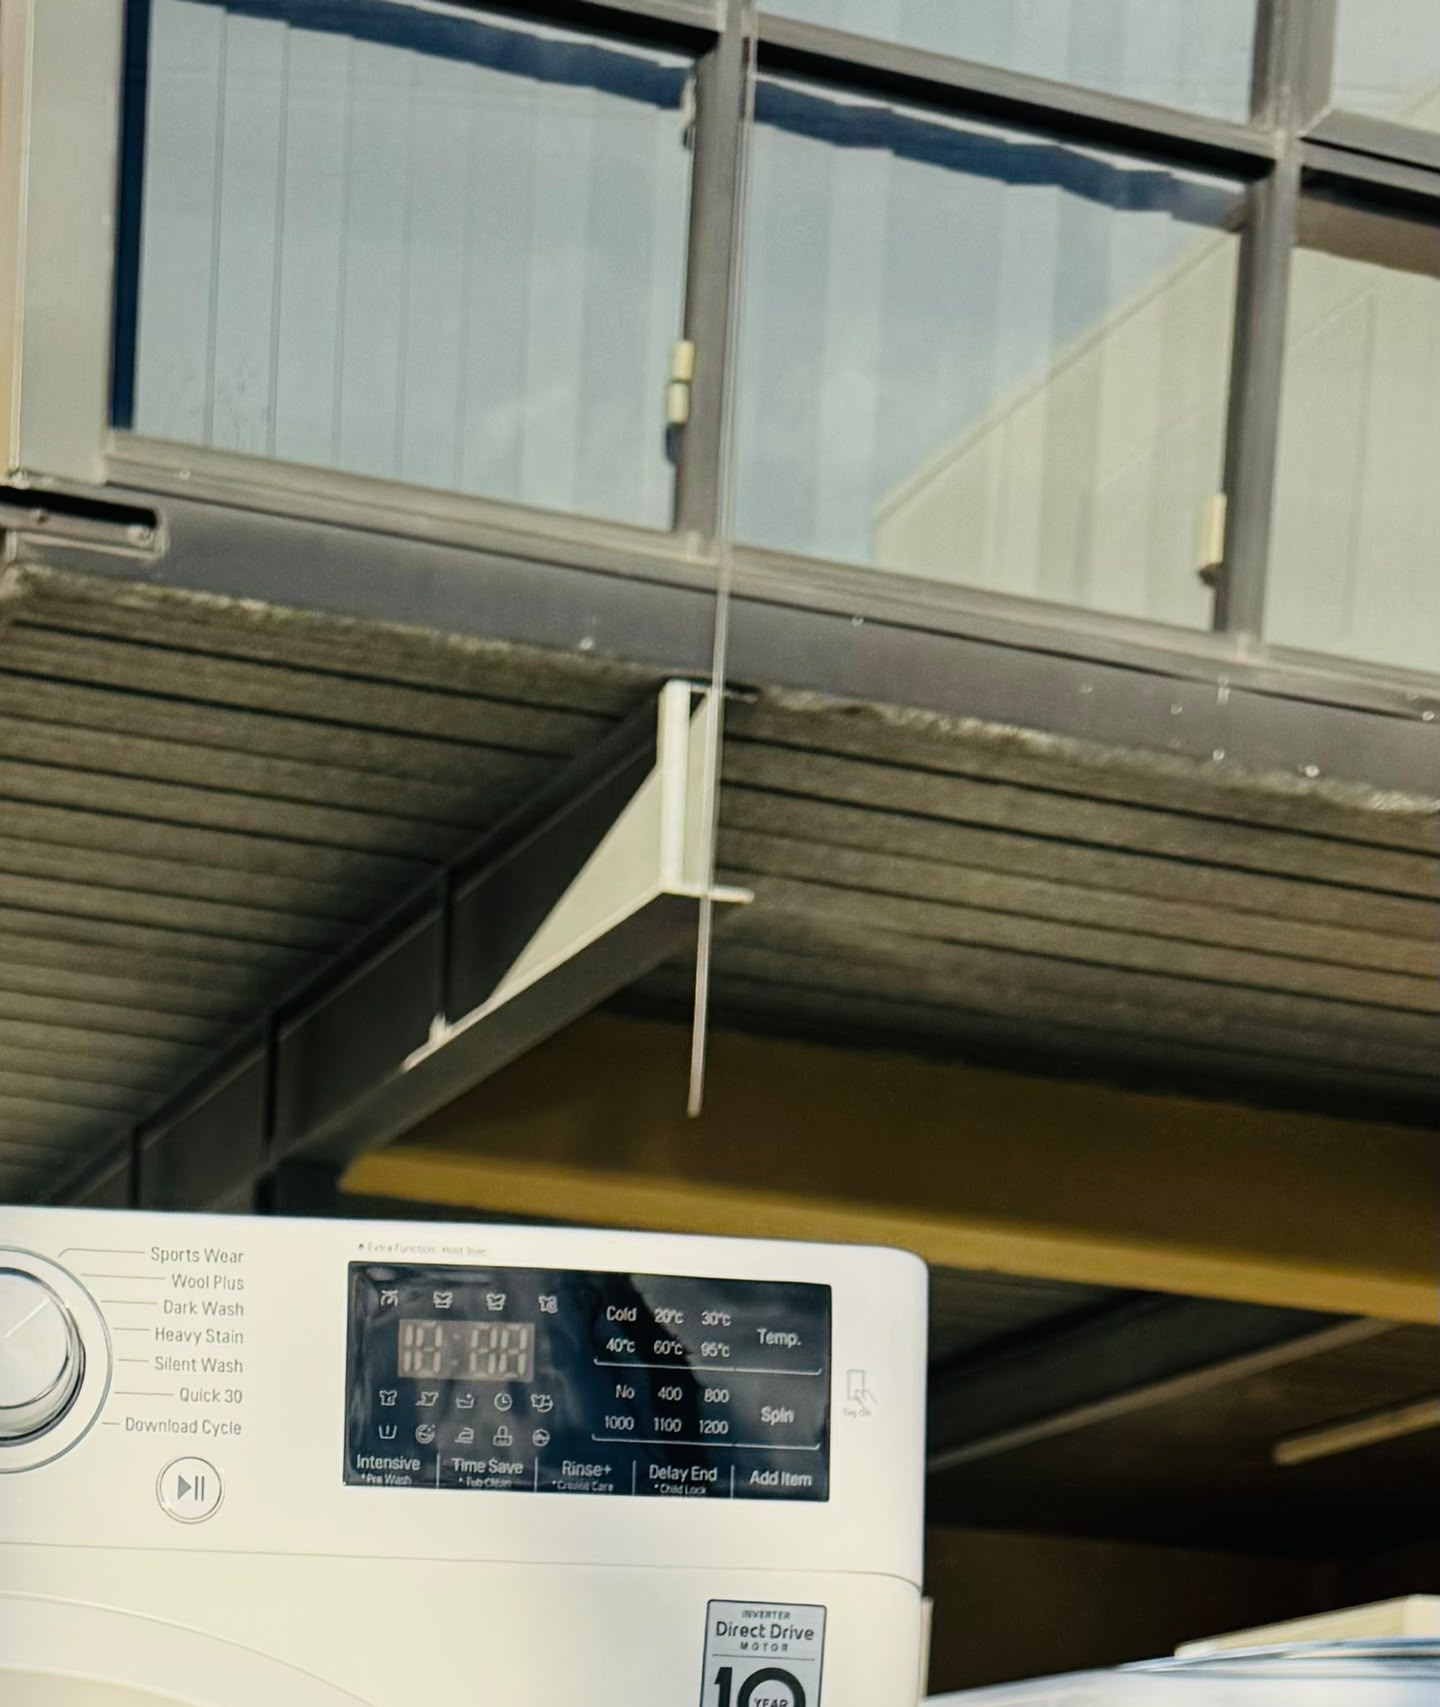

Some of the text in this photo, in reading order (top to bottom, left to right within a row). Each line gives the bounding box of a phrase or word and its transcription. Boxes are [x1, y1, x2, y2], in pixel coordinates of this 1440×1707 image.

[150, 1247, 244, 1265] Sports Wear
[172, 1273, 245, 1291] Wool Plus
[163, 1300, 244, 1318] Dark Wash
[606, 1306, 637, 1322] Cold
[154, 1328, 244, 1346] Heavy Stain
[757, 1328, 802, 1348] Temp.
[154, 1356, 244, 1374] Silent Wash
[179, 1387, 243, 1404] Quick 30
[615, 1384, 730, 1404] No 400 800
[604, 1415, 729, 1434] 1000 1100 1200
[760, 1405, 794, 1426] Spin
[125, 1418, 242, 1438] Download Cycle
[356, 1454, 523, 1474] Intensive Time Save
[562, 1460, 612, 1478] Rinse+
[649, 1464, 718, 1483] Delay End
[749, 1470, 812, 1487] Add Item
[742, 1610, 791, 1620] INVERTER
[716, 1620, 814, 1641] Direct Drive
[740, 1641, 789, 1652] MOTOR
